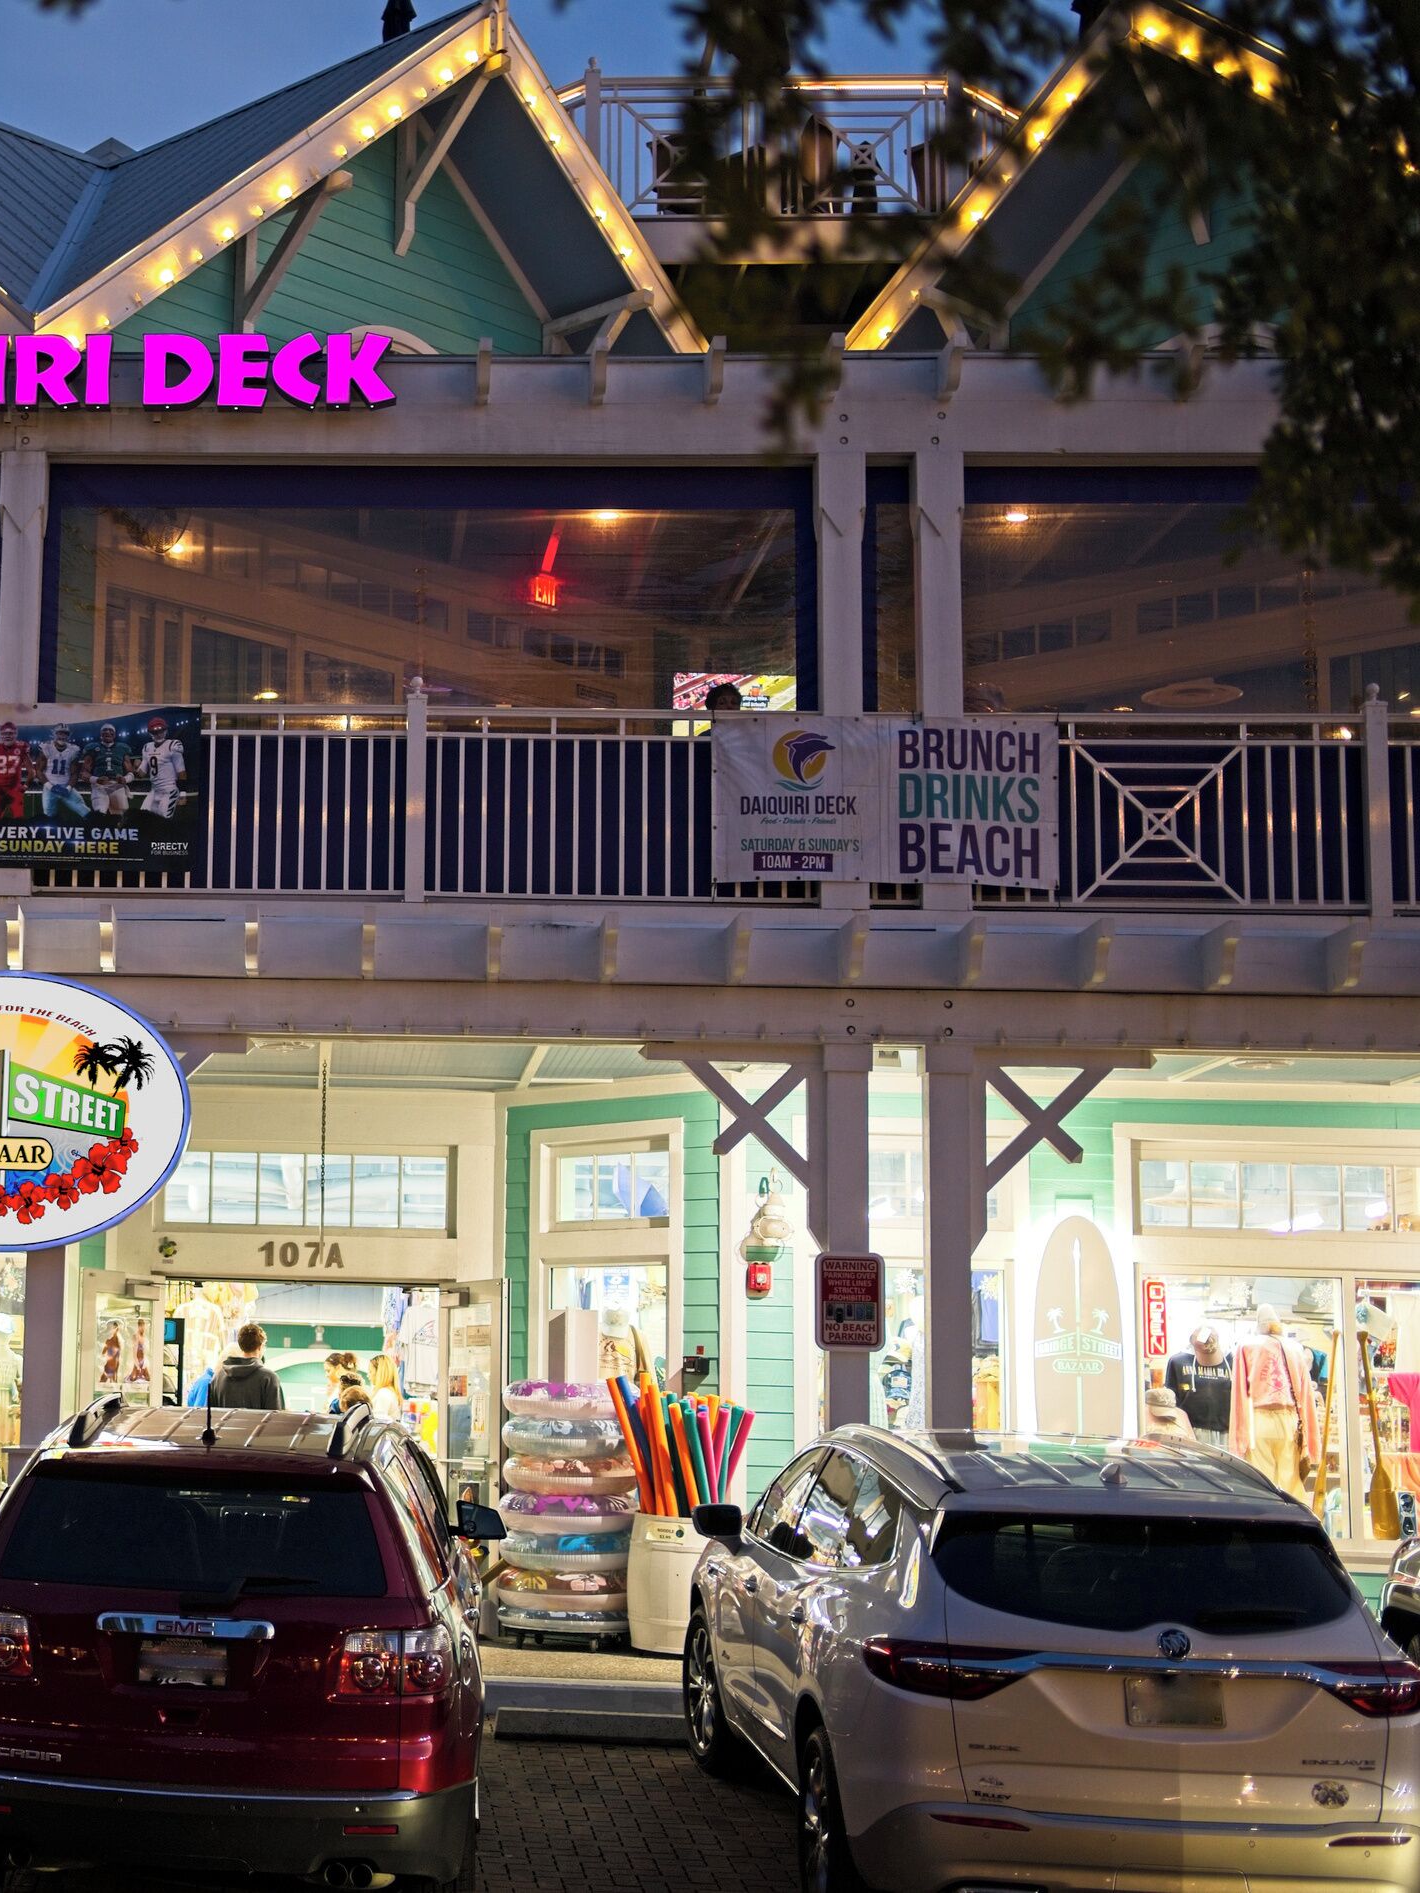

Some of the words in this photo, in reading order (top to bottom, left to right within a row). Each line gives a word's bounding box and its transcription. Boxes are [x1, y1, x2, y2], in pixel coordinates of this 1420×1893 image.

[142, 332, 396, 411] DECK
[898, 728, 1040, 774] BRUNCH
[51, 759, 67, 775] 11
[104, 757, 113, 771] 1
[149, 756, 159, 777] 9
[740, 796, 810, 816] DAIQUIRI
[815, 796, 857, 816] DECK
[898, 773, 1040, 824] DRINKS
[760, 817, 777, 825] Food
[46, 827, 85, 840] LIVE
[91, 827, 139, 842] GAME
[74, 841, 119, 855] HERE
[151, 842, 189, 851] DIRECTV
[740, 838, 795, 852] SATURDAY
[798, 839, 806, 851] &
[808, 839, 860, 853] SUNDAY'S
[898, 823, 1040, 879] BEACH
[761, 855, 791, 869] 10AM
[801, 856, 825, 869] 2PM
[29, 1006, 53, 1018] THE
[55, 1013, 97, 1037] BEACH
[13, 1073, 120, 1132] STREET
[258, 1241, 344, 1268] 107A
[825, 1262, 875, 1271] WARNING
[1149, 1284, 1165, 1354] OPEN
[843, 1324, 875, 1332] BEACH
[828, 1332, 872, 1341] PARKING
[1057, 1360, 1101, 1371] BAZAAR
[156, 1620, 215, 1635] GMC
[968, 1743, 1021, 1752] BUICK
